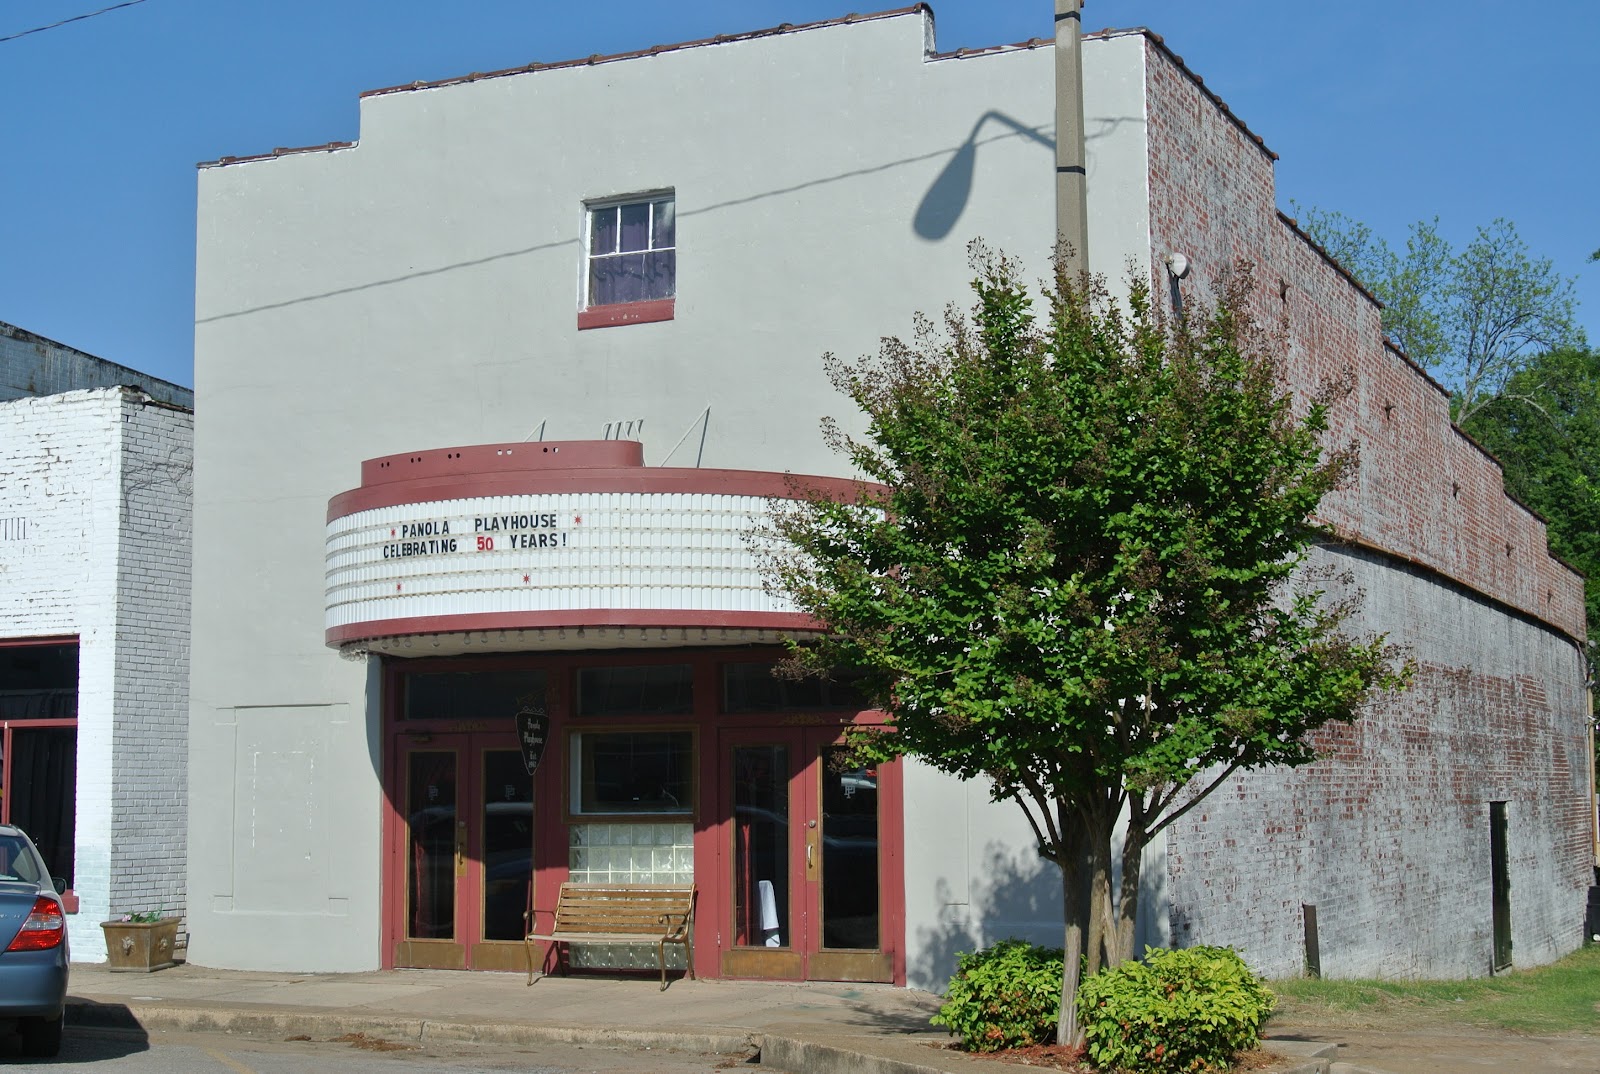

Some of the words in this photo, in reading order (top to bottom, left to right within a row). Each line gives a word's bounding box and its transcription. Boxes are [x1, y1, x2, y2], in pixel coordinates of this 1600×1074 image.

[402, 520, 450, 538] PANOLA
[474, 513, 557, 532] PLAYHOUSE
[383, 538, 457, 559] CELEBRATING
[476, 536, 494, 551] 50
[510, 532, 567, 549] YEARS!
